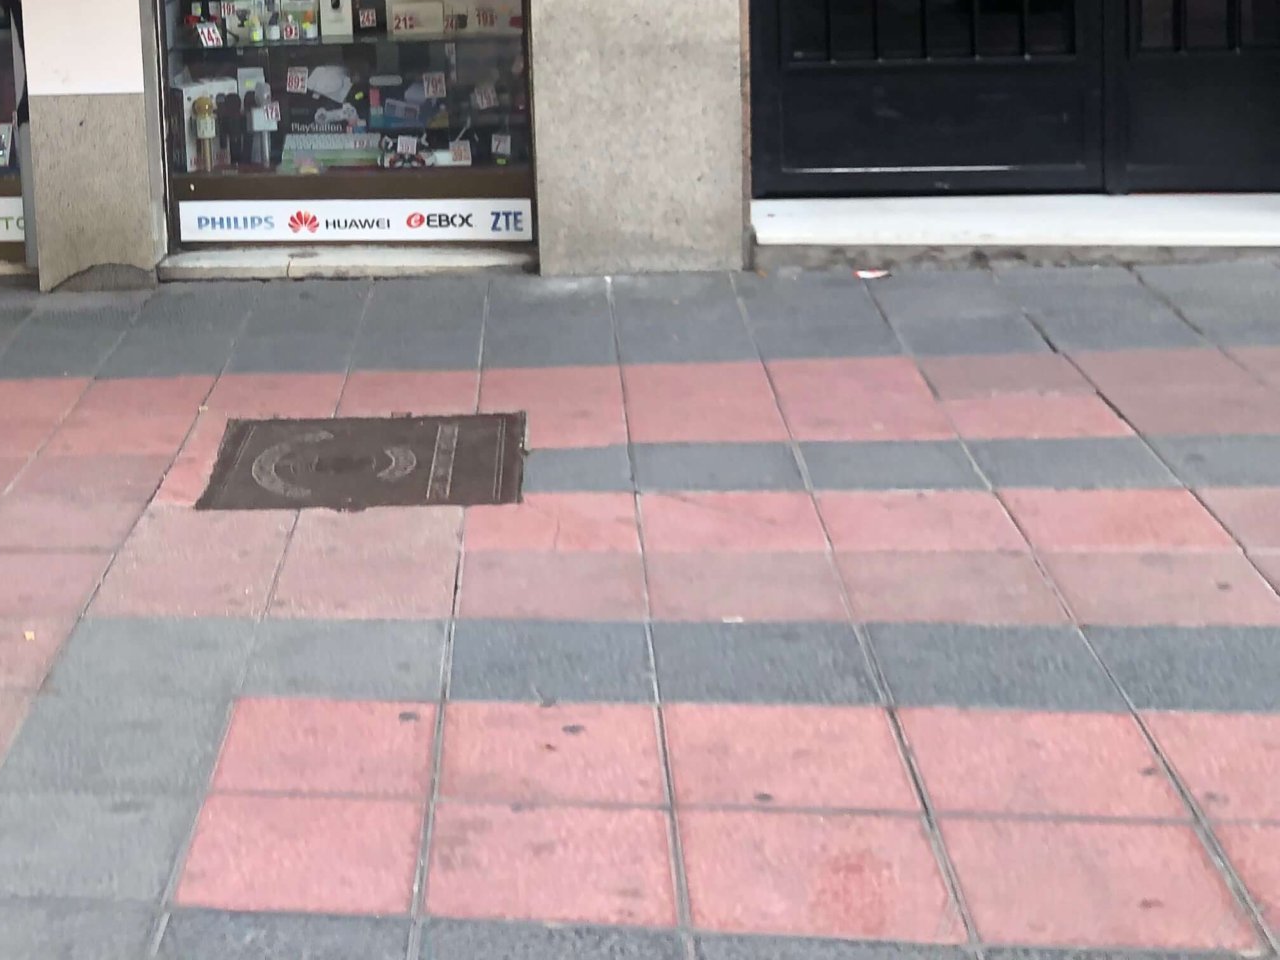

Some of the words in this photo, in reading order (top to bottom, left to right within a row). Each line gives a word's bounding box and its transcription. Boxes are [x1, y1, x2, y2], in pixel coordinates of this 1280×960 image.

[197, 214, 275, 230] PHILIPS
[325, 218, 391, 230] HUAWEI
[490, 211, 524, 231] ZTE
